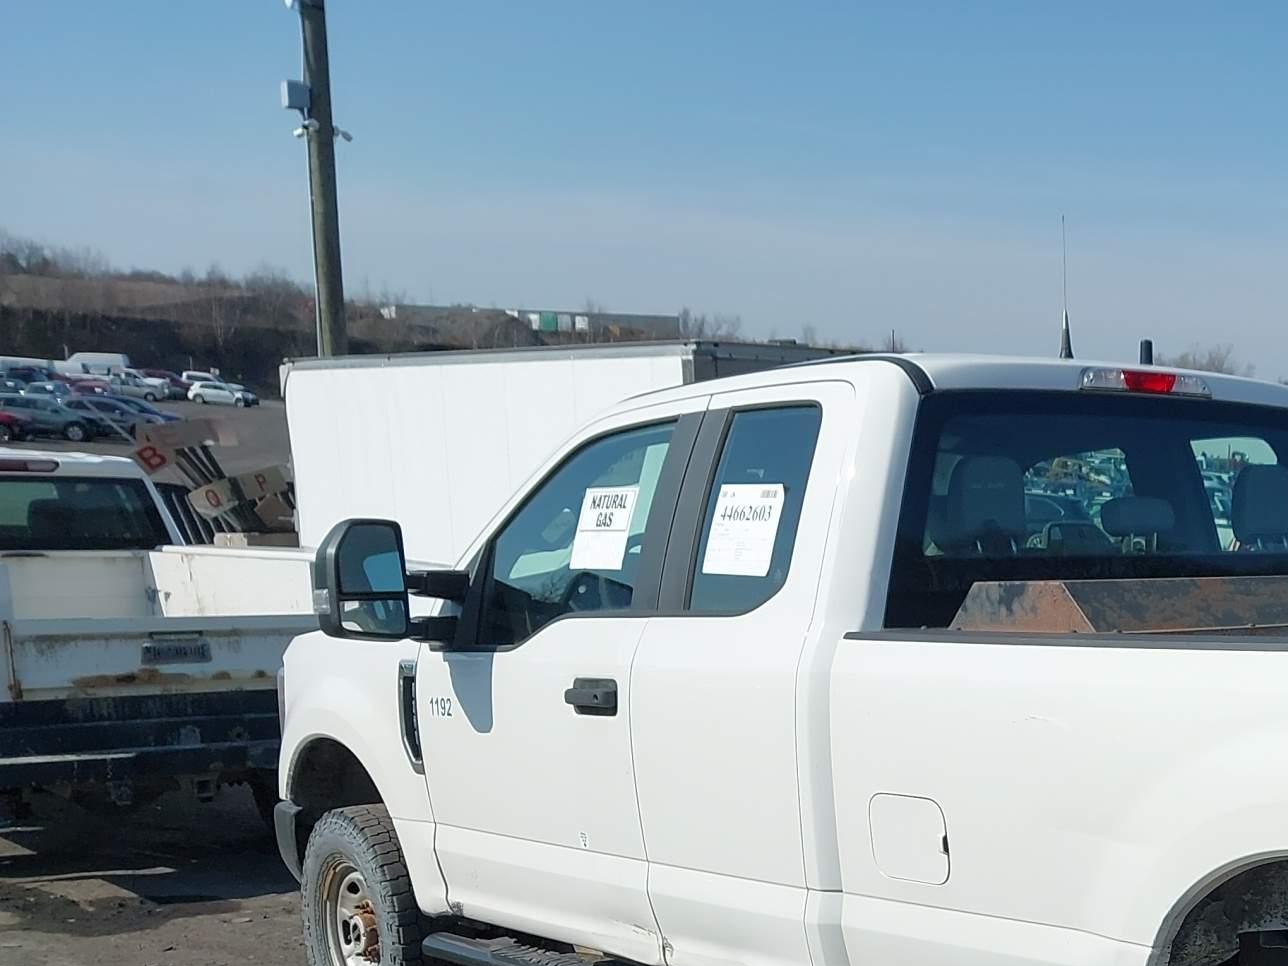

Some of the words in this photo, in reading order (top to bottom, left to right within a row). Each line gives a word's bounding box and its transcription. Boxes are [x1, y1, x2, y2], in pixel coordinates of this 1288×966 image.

[136, 446, 167, 471] B
[254, 473, 266, 491] P
[590, 493, 628, 510] NATURAL
[595, 511, 614, 528] GAS
[720, 505, 772, 521] 44662603
[429, 697, 453, 716] 1192
